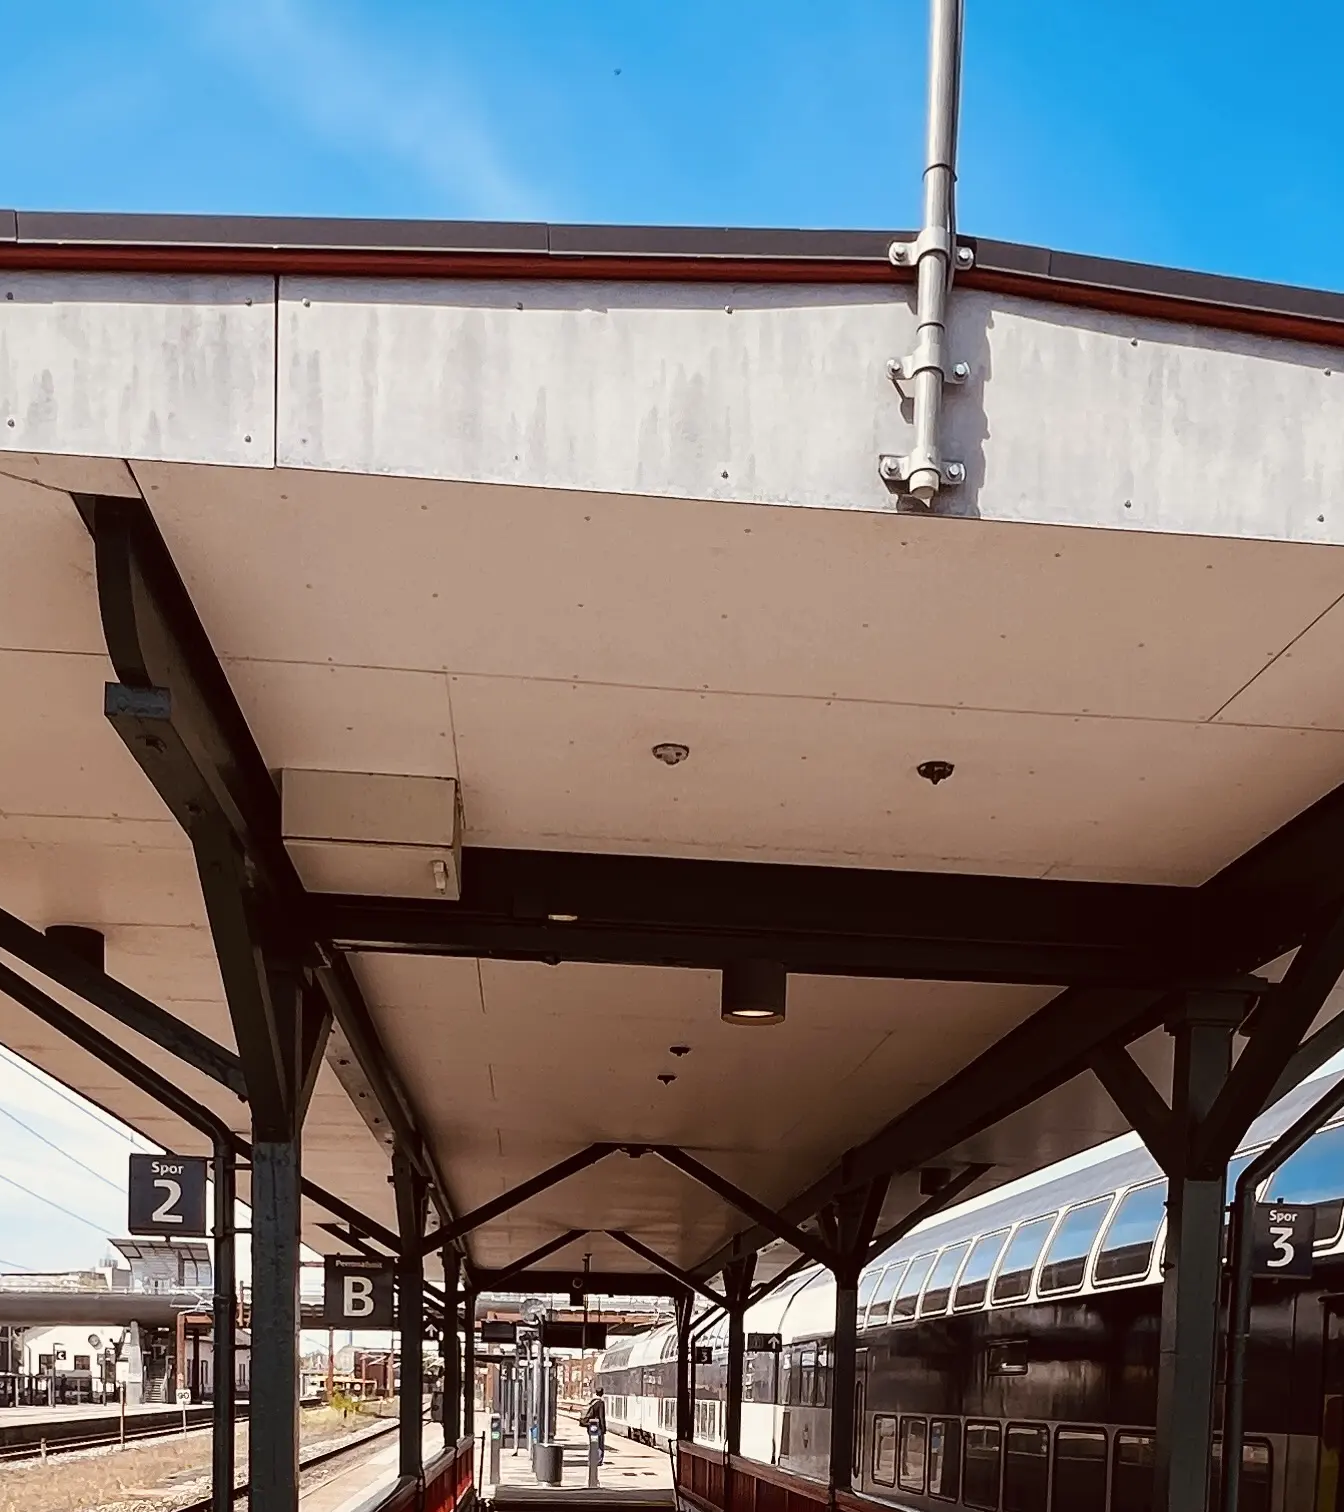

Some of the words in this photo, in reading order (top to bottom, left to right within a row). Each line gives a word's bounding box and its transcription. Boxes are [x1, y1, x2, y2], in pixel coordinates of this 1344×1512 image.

[151, 1161, 184, 1176] Spor
[152, 1178, 183, 1223] 2
[1269, 1209, 1298, 1223] Spor
[1267, 1226, 1294, 1267] 3
[343, 1276, 374, 1316] B
